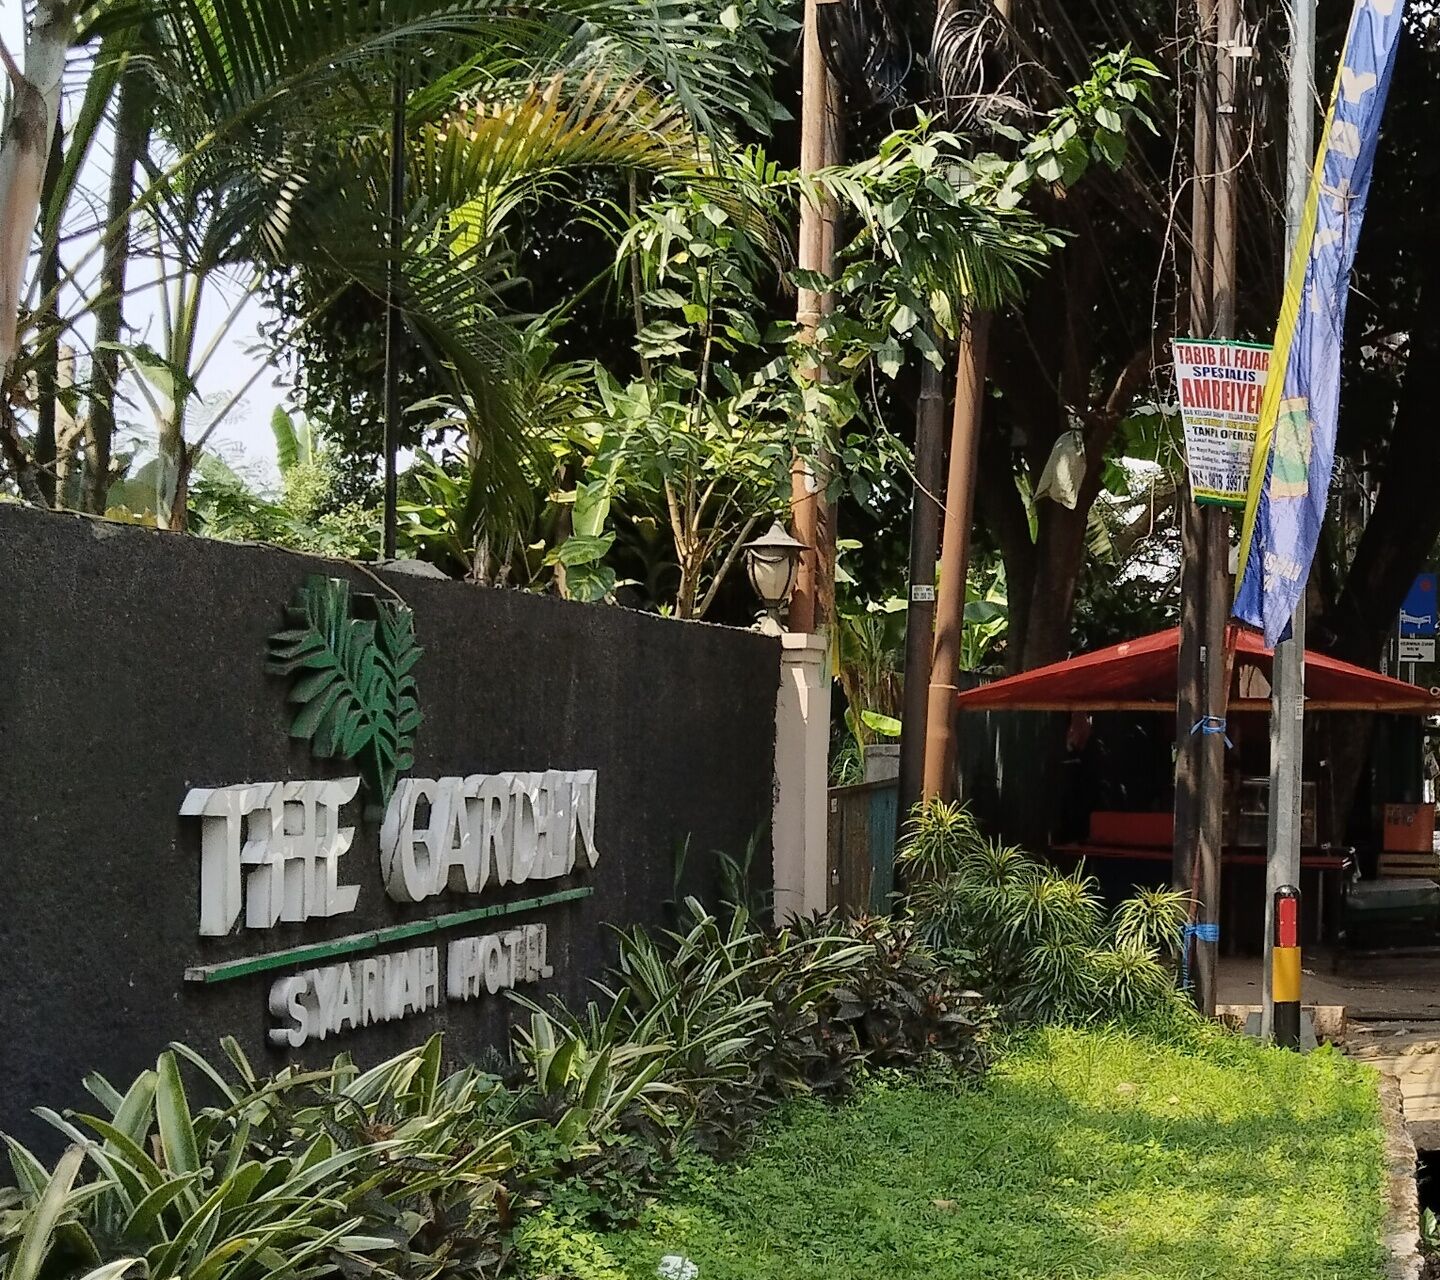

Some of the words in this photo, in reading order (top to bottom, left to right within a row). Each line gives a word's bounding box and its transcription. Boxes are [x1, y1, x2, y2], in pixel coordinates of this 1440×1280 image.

[1177, 345, 1217, 366] TABIB
[1219, 347, 1232, 367] AL
[1234, 349, 1269, 371] FAJAR
[1192, 366, 1257, 382] SPESIALIS
[179, 777, 361, 936] THE
[381, 769, 599, 902] GARDEN
[269, 946, 439, 1047] SYARIAH
[447, 923, 553, 1002] HOTEL
